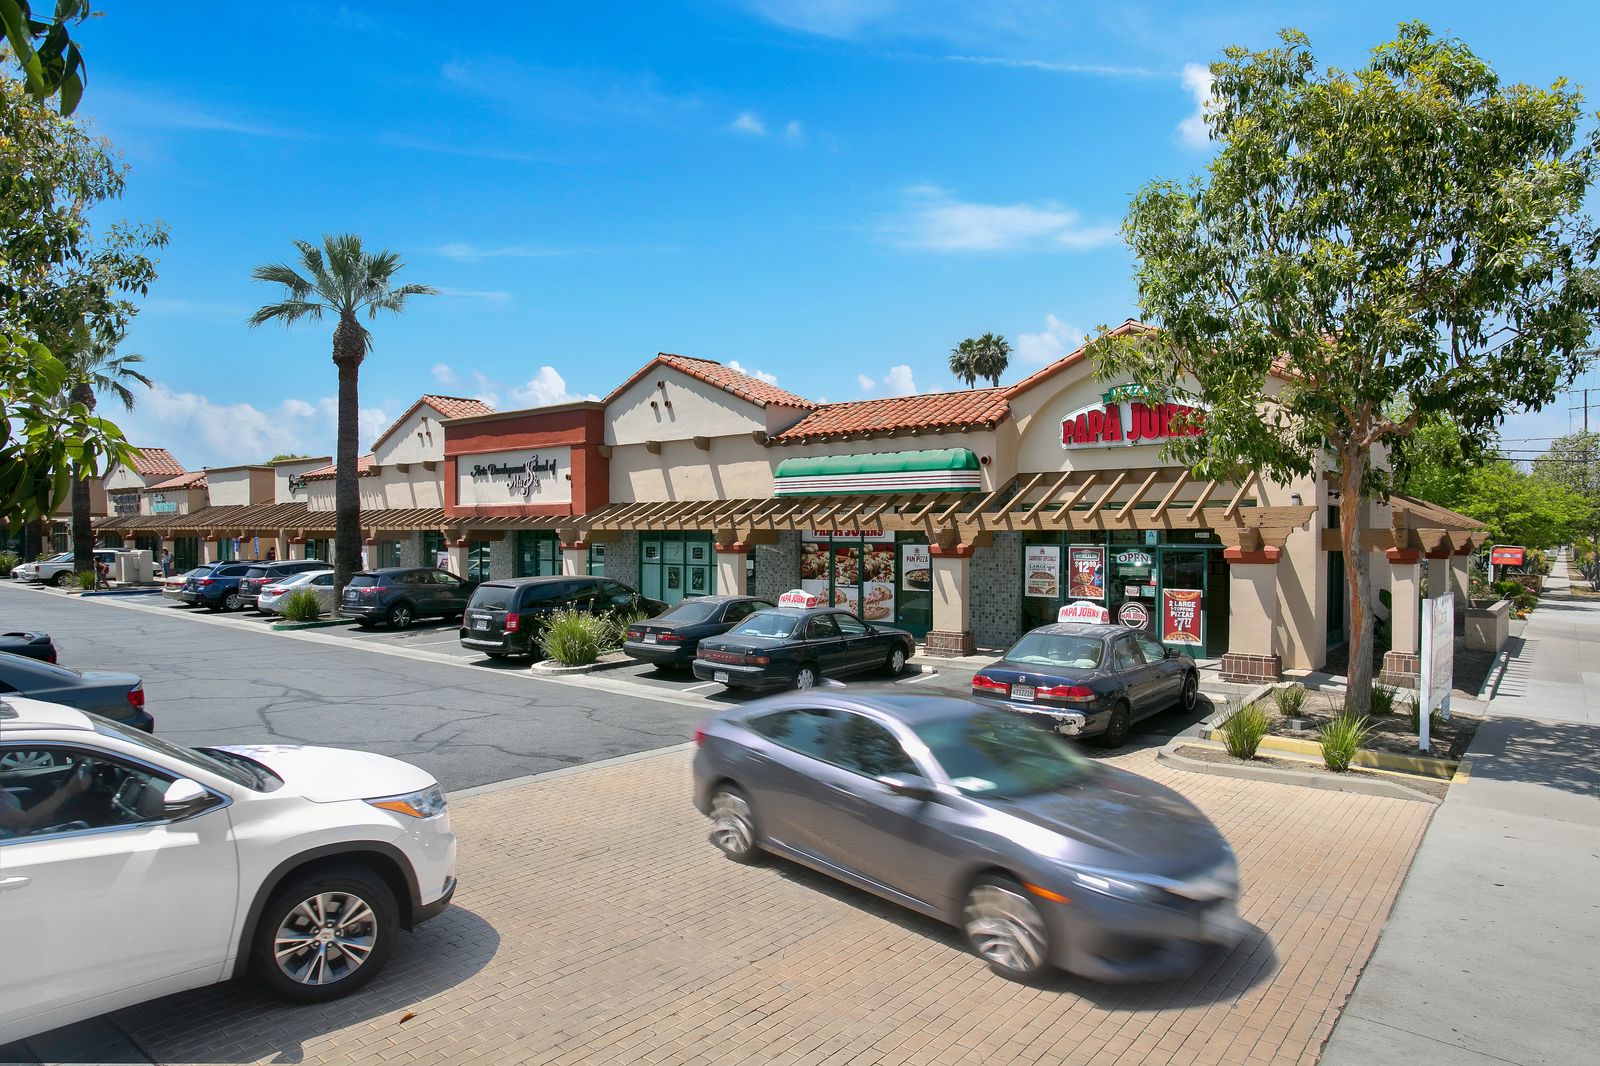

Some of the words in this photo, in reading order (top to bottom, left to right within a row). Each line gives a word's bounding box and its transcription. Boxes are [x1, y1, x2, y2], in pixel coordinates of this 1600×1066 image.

[1062, 404, 1123, 445] PAPA
[549, 459, 557, 475] of
[906, 555, 915, 563] PAN
[916, 555, 928, 563] PIZZA
[1118, 552, 1149, 563] OPEN
[780, 593, 792, 603] PAPA
[1061, 606, 1077, 617] PAPA
[1078, 606, 1099, 618] JOHNS
